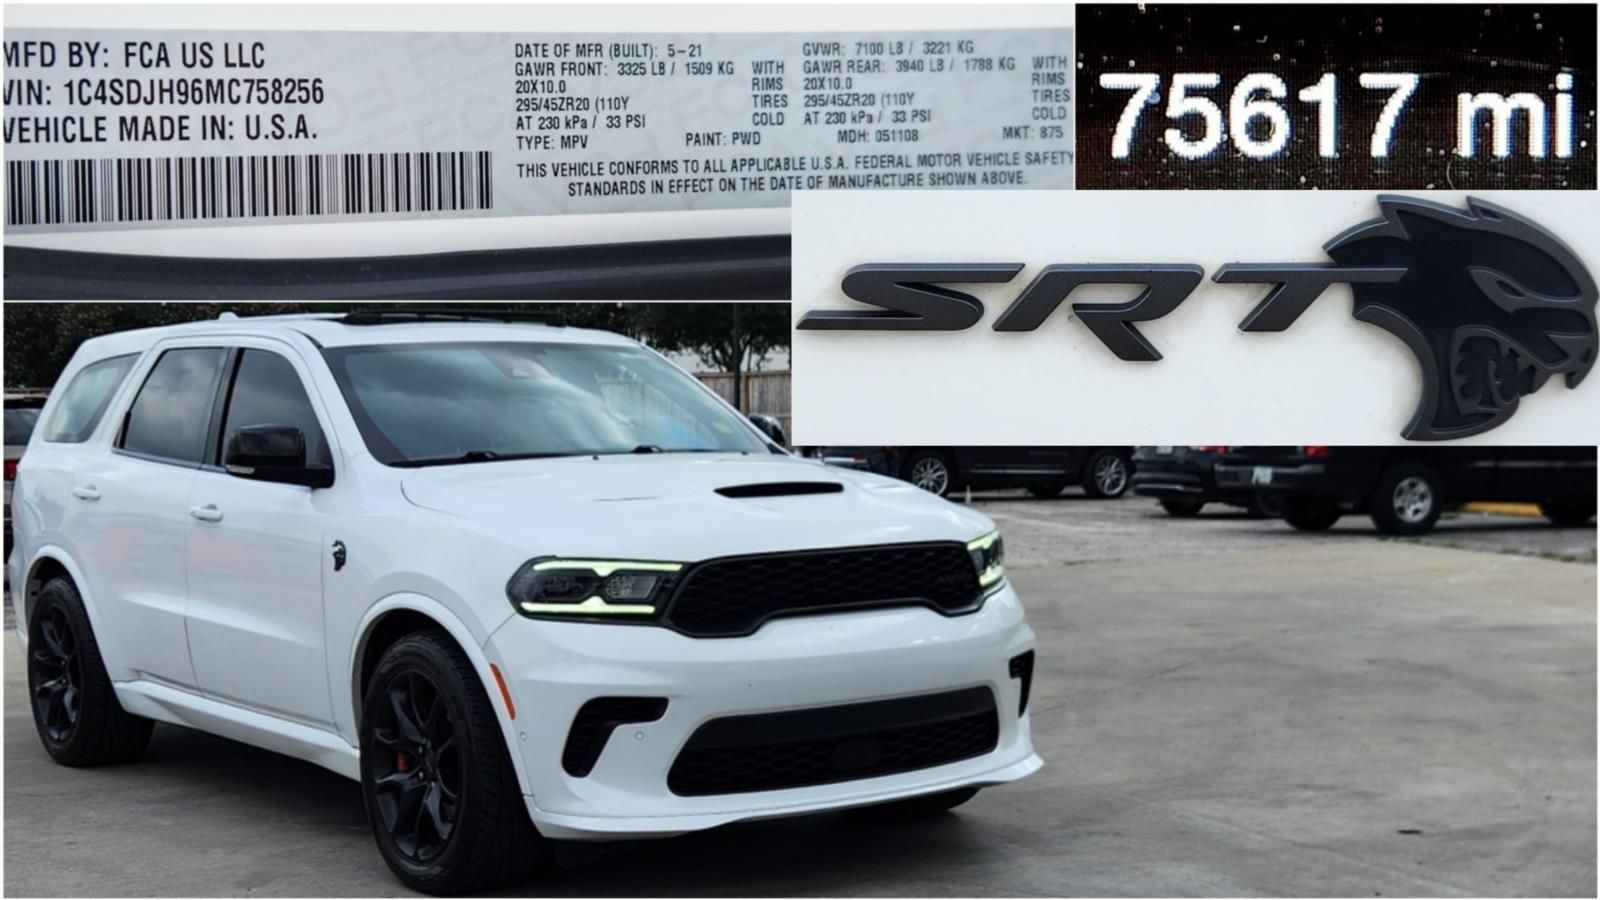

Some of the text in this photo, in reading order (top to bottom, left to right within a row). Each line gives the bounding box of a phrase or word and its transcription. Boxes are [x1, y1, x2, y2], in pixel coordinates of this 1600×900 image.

[4, 40, 265, 69] MFD BY: FCA US LLC
[515, 43, 549, 58] DATE
[553, 43, 570, 58] OF
[576, 43, 604, 58] MFR
[609, 43, 658, 61] (BUILT):
[803, 40, 974, 56] GVWR: 7100 LB / 3221 KG
[515, 61, 734, 77] GAWR FRONT: 3325 LB / 1509 KG
[752, 60, 784, 75] WITH
[803, 57, 1015, 74] GAWR REAR: 3940 LB / 1788 KG
[1032, 55, 1067, 70] WITH
[515, 79, 566, 94] 20X10.0
[752, 77, 784, 91] RIMS
[803, 76, 852, 91] 20X10.0
[1032, 72, 1065, 85] RIMS
[4, 77, 324, 106] VIN: 1C4SDJH96MC758256
[1032, 88, 1070, 103] TIRES
[515, 96, 629, 114] 295/45ZR20 (110Y
[752, 94, 788, 108] TIRES
[804, 92, 915, 109] 295/45ZR20 (110Y
[752, 111, 784, 126] COLD
[803, 109, 931, 125] AT 230 kPa / 33 PSI
[1032, 106, 1066, 120] COLD
[1100, 73, 1574, 159] 75617 mi
[4, 113, 317, 144] VEHICLE MADE IN: U.S.A.
[516, 114, 645, 130] AT 230 kPa / 33 PSI
[686, 131, 761, 147] PAINT: PWD
[837, 129, 919, 143] MDH: 051108
[1002, 125, 1063, 139] MKT: 875
[516, 134, 588, 150] TYPE: MPV
[516, 151, 1073, 178] THIS VEHICLE CONFORMS TO ALL APPLICABLE U.S.A. FEDERAL MOTOR VEHICLE SAFETY
[568, 170, 1028, 197] STANDARDS IN EFFECT ON THE DATE OF MANUFACTURE SHOWN ABOVE.
[796, 263, 1407, 361] SRT
